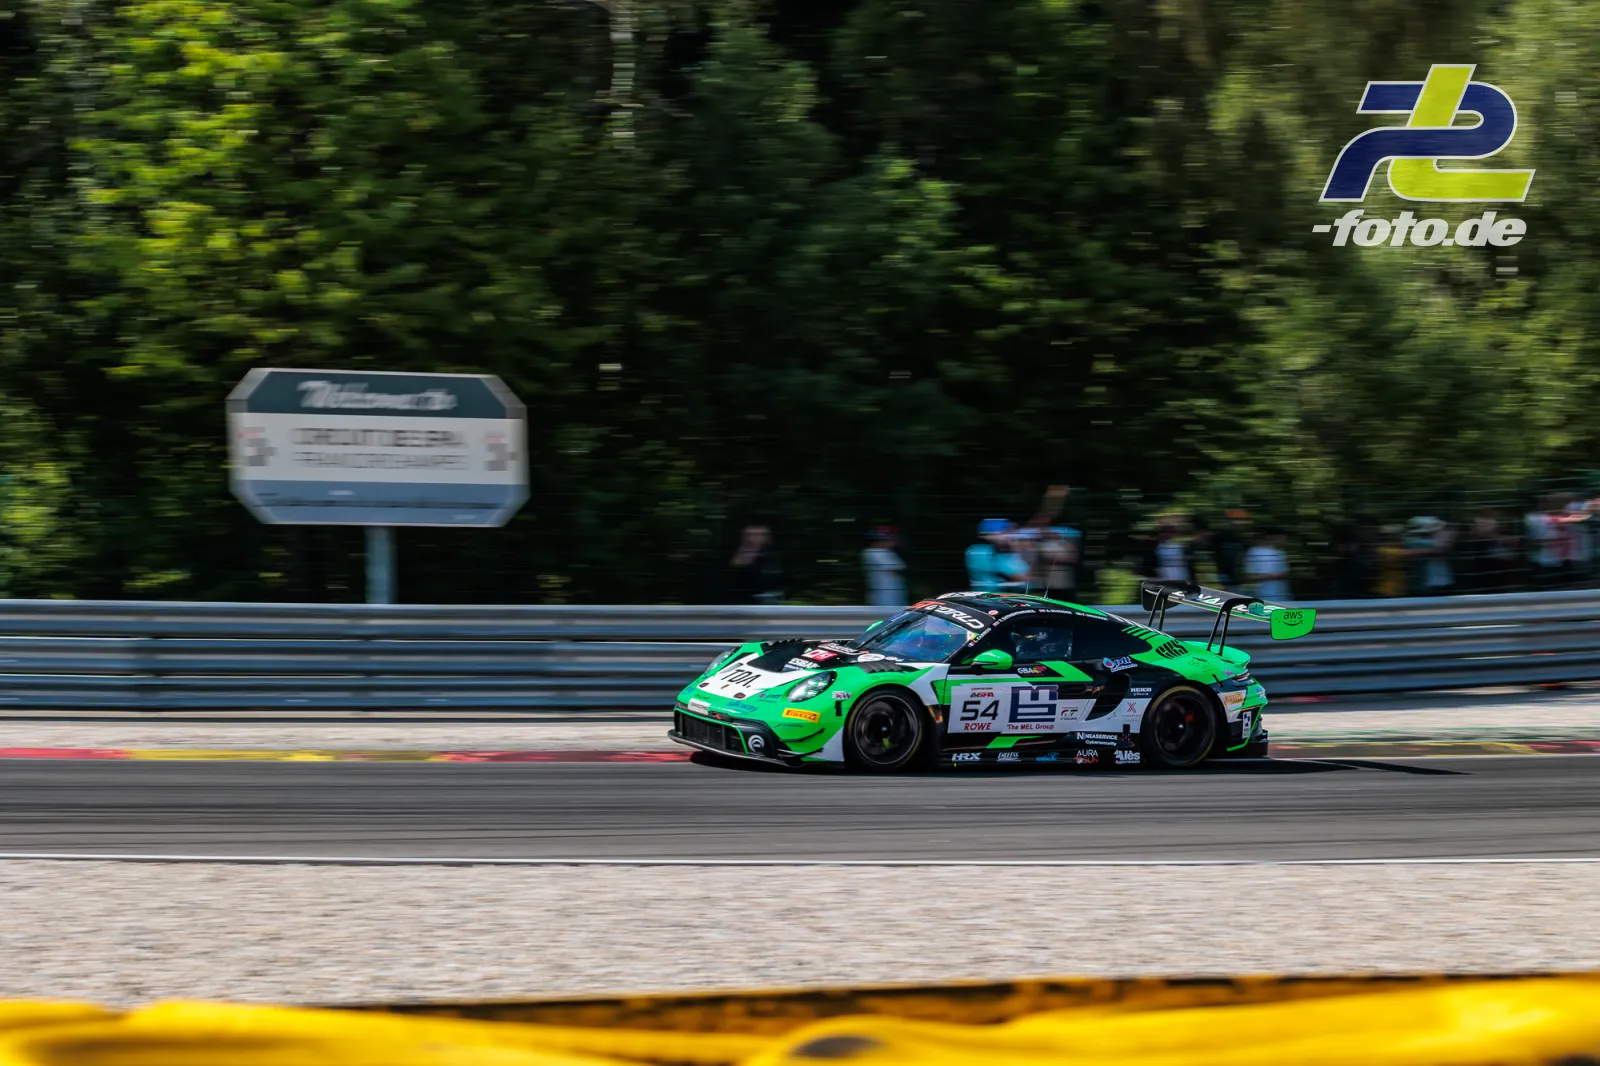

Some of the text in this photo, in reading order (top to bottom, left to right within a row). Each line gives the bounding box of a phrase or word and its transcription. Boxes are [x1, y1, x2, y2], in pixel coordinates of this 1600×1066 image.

[1283, 610, 1303, 620] aws
[960, 699, 1000, 721] 54
[964, 722, 992, 731] ROWE
[1035, 723, 1055, 731] Group
[952, 752, 982, 761] HRX
[1076, 749, 1099, 757] AURA
